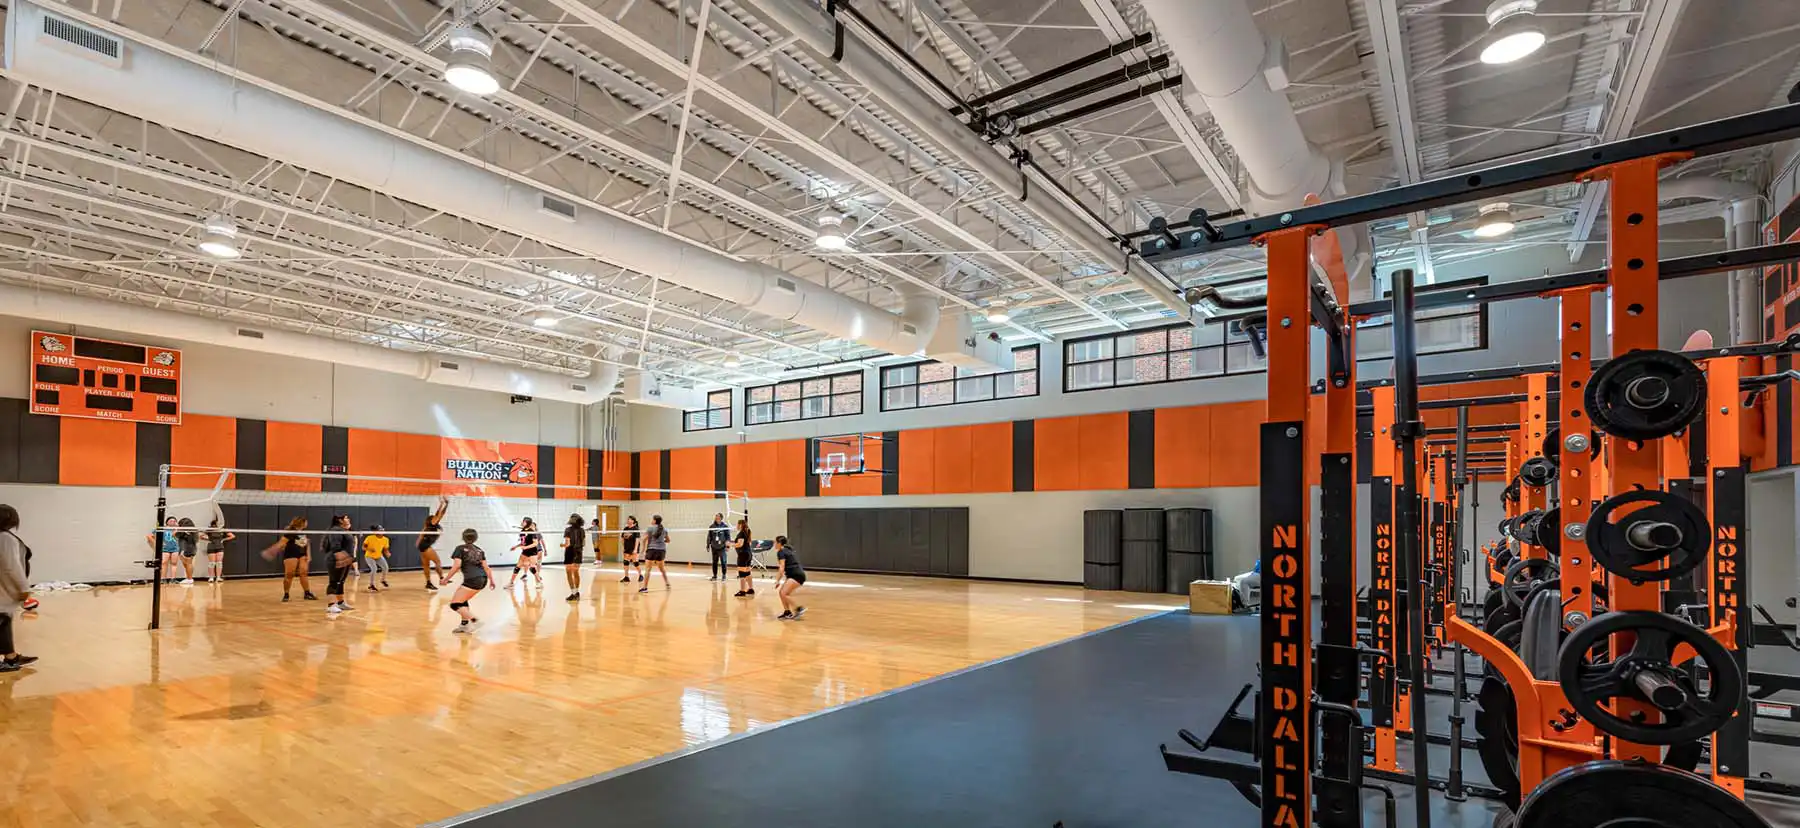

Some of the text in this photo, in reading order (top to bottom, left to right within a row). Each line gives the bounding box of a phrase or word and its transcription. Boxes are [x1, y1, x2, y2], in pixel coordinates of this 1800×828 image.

[42, 355, 75, 366] HOME
[97, 365, 124, 374] PERIOD
[142, 367, 175, 377] GUEST
[84, 388, 134, 399] PLAYER FOUL
[96, 411, 122, 419] MATCH
[447, 460, 502, 471] BULLDOG
[457, 469, 501, 479] NATION
[1376, 524, 1390, 590] NORTH
[1717, 525, 1737, 607] NORTH
[1272, 525, 1297, 667] NORTH
